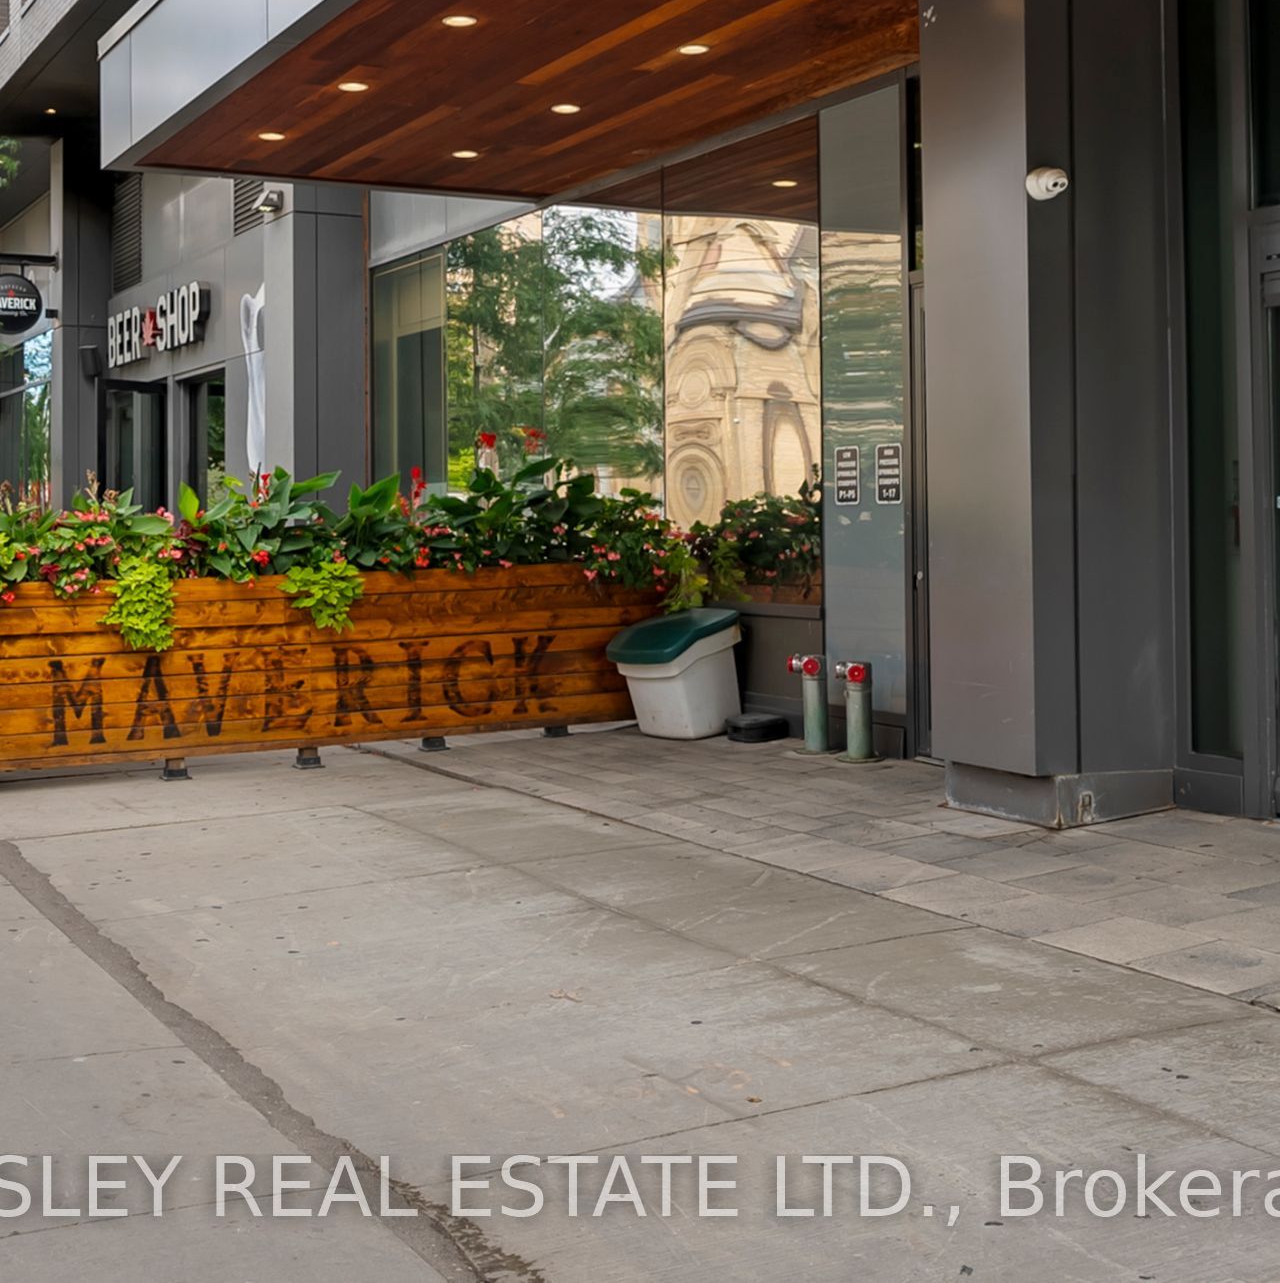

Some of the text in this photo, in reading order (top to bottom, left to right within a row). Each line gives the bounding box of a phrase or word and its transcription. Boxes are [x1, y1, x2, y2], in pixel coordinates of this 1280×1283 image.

[108, 281, 200, 369] BEER SHOP
[47, 635, 573, 747] MAVERICK
